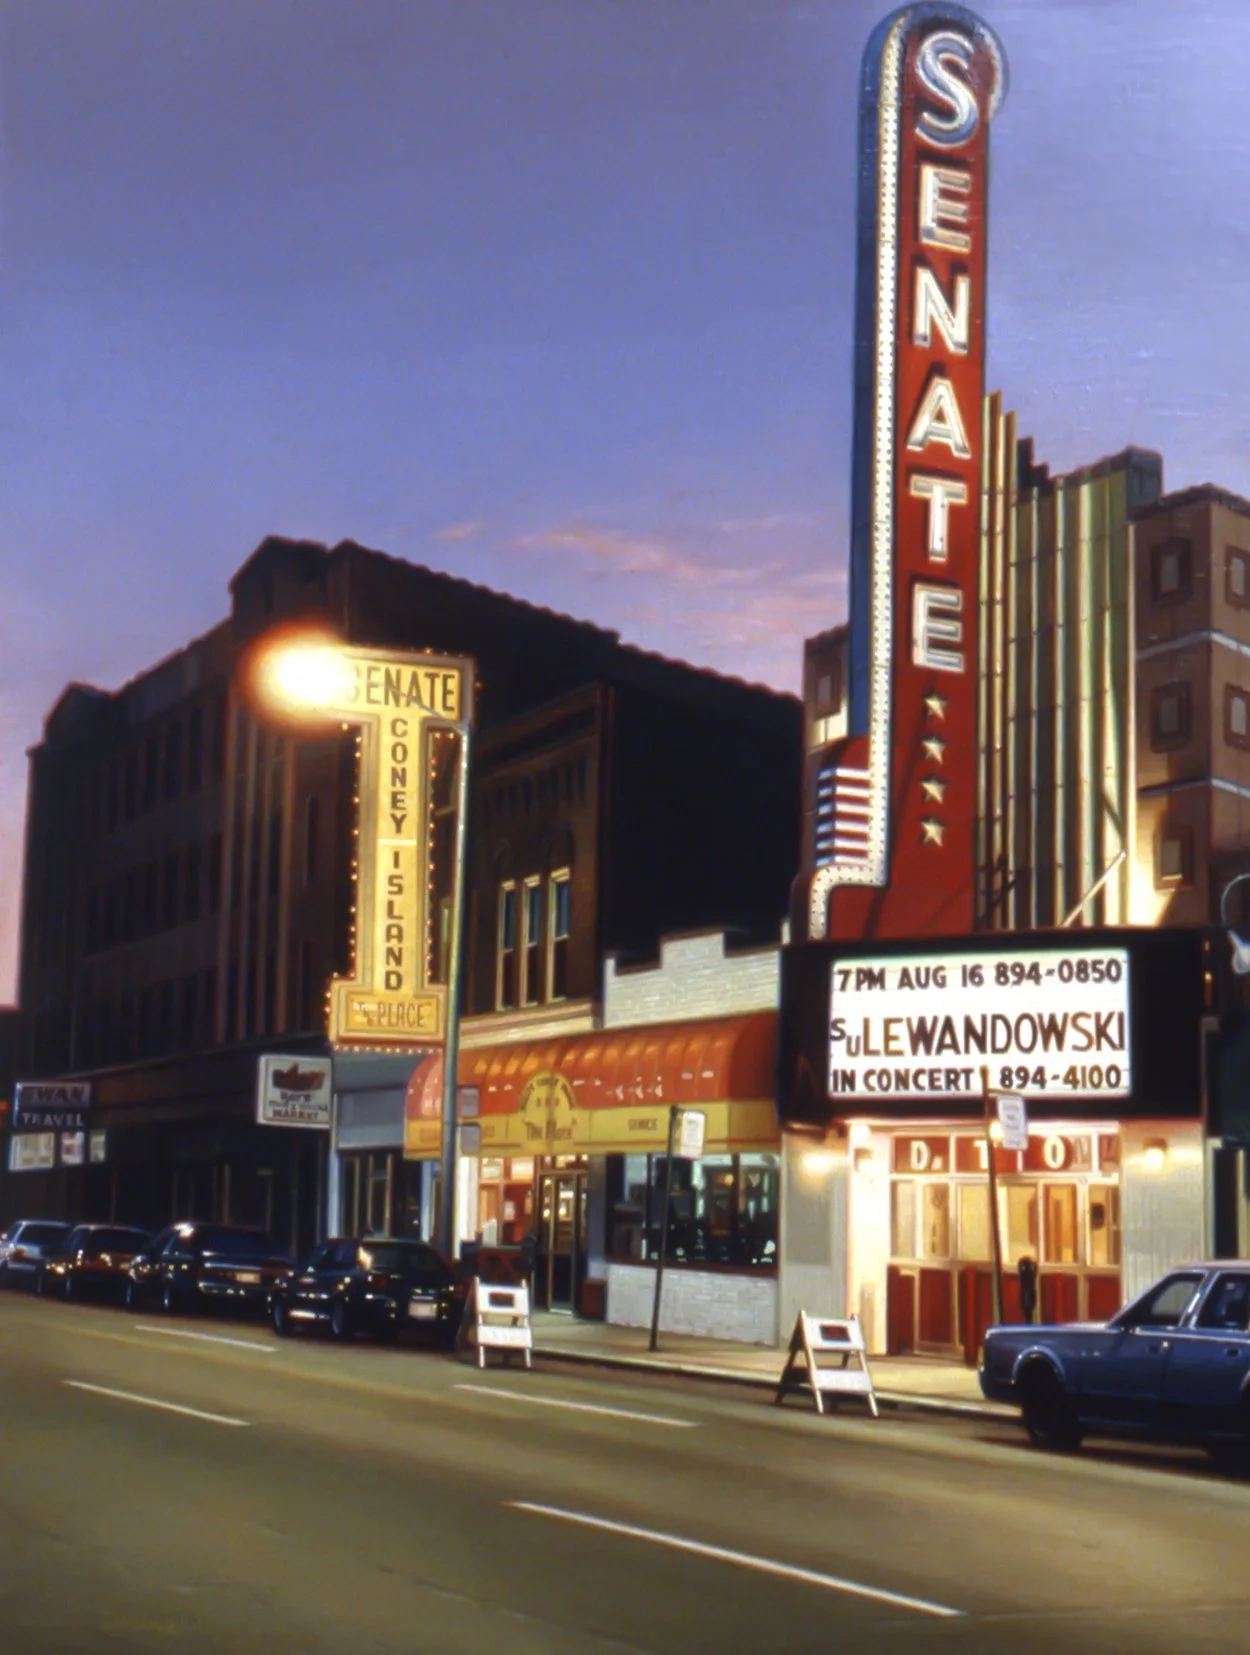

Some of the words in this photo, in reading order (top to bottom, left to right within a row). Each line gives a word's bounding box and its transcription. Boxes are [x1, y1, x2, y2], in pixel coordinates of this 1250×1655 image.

[906, 31, 980, 674] SENATE
[389, 717, 409, 835] CONEY
[384, 851, 404, 991] ISLAND
[898, 965, 947, 991] AUG
[961, 963, 985, 988] 16
[995, 958, 1122, 987] 894-0850
[832, 1068, 856, 1092] IN
[862, 1066, 975, 1092] CONCERT
[999, 1064, 1122, 1090] 894-4100
[21, 1112, 85, 1127] TRAVEL
